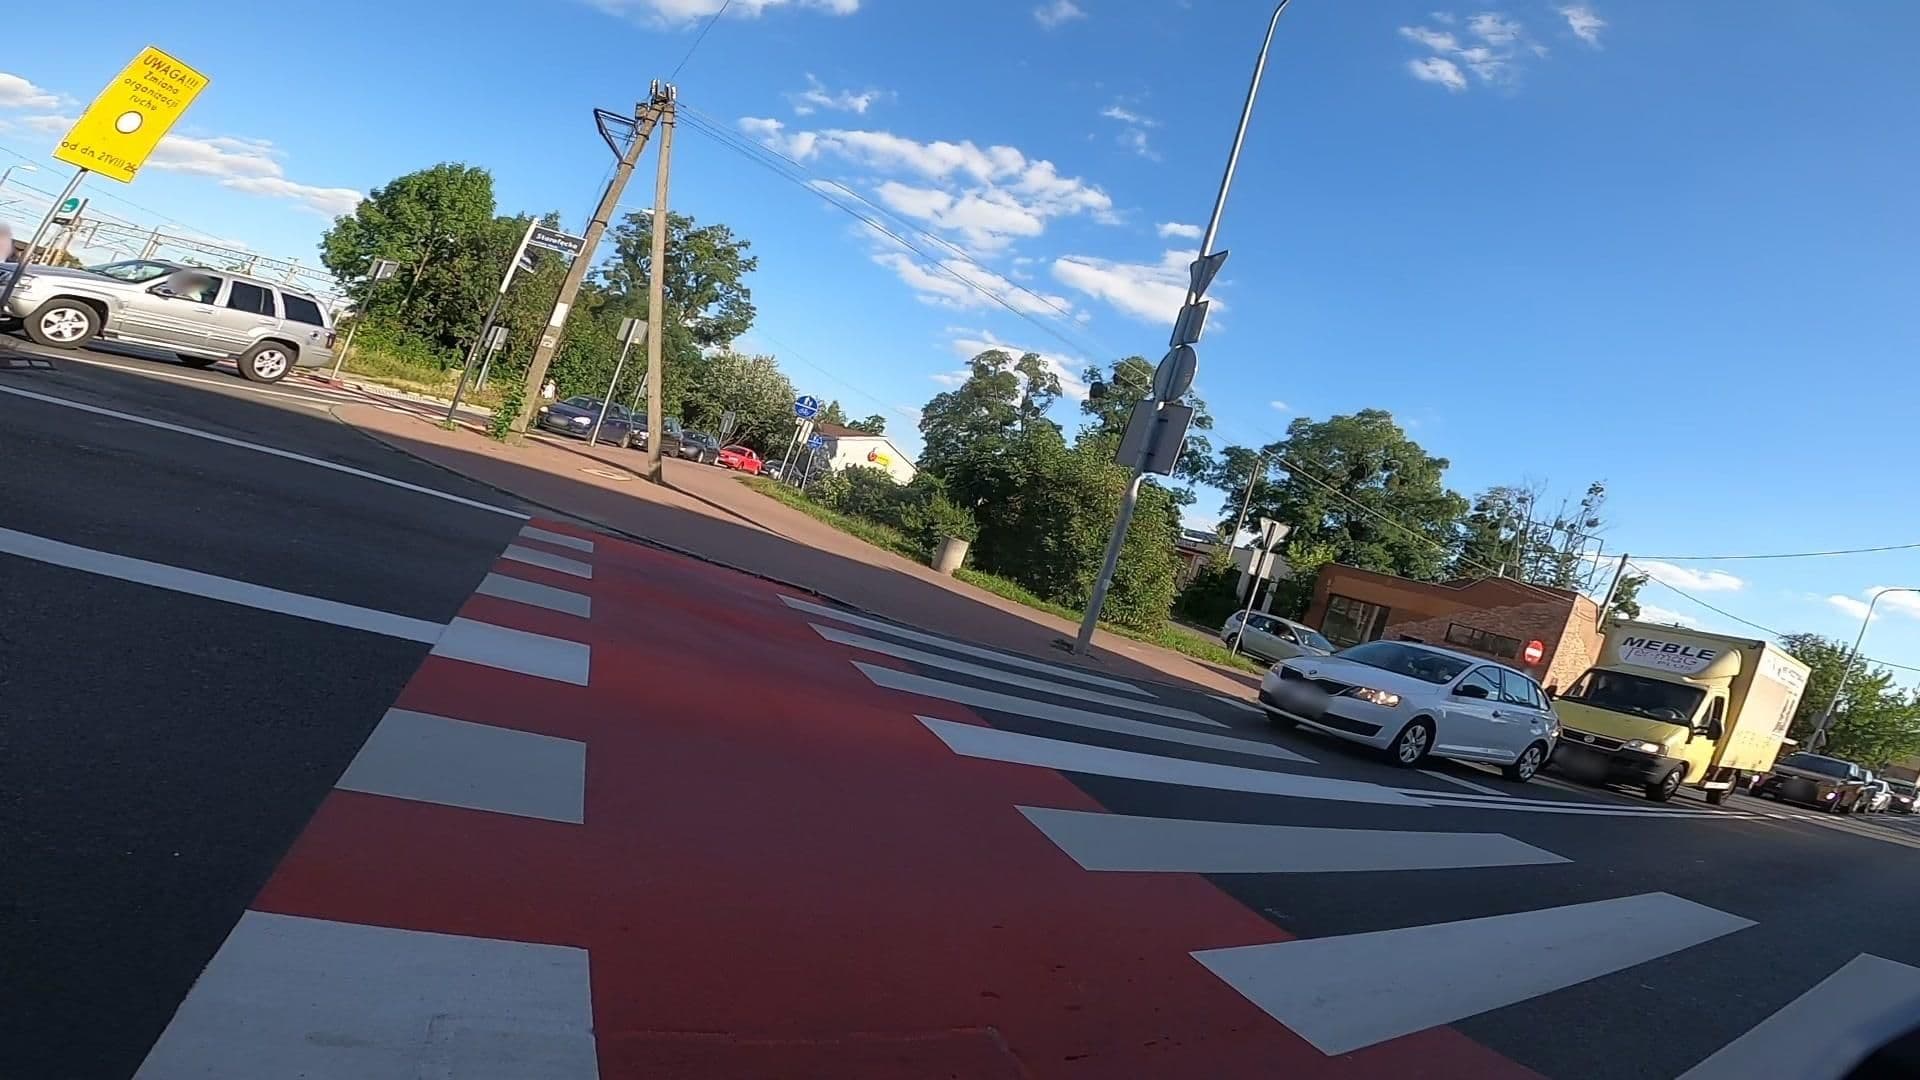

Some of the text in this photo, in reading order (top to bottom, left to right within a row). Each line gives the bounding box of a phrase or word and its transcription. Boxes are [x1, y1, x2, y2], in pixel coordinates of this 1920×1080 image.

[143, 54, 199, 91] UWAGA!!!
[143, 70, 179, 95] Zmiana
[124, 77, 179, 108] organizacji
[130, 94, 158, 111] ruchu
[61, 141, 78, 151] od
[1622, 636, 1717, 661] MEBLE
